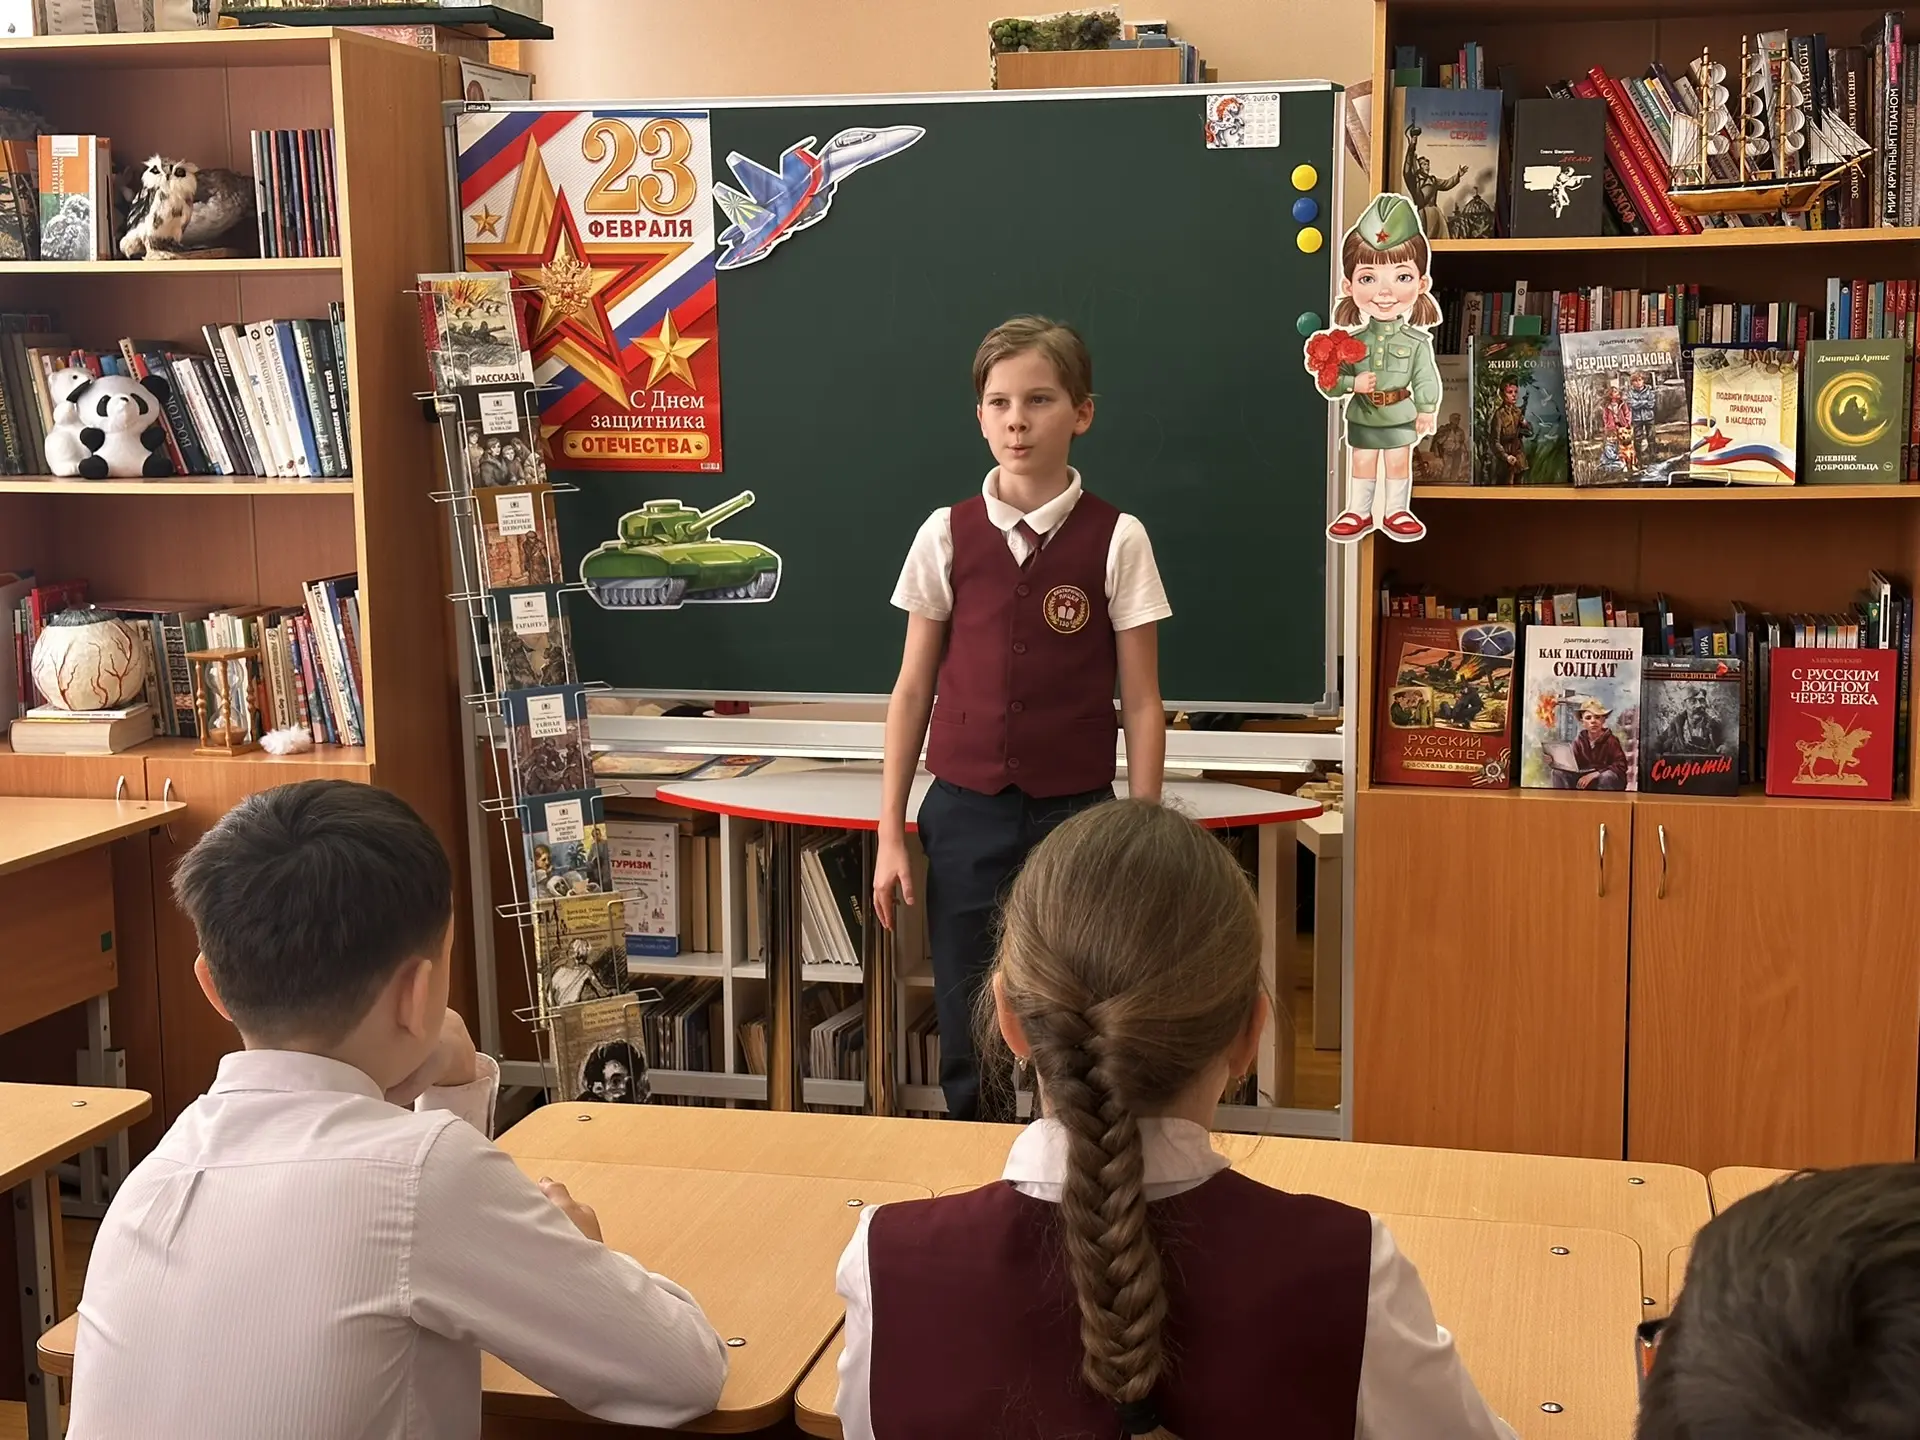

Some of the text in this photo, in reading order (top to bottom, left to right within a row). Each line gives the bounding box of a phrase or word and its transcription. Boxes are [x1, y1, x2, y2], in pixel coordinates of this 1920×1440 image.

[1847, 71, 1856, 111] ДИСНЕЯ
[1613, 104, 1635, 136] ИСТОРИИ
[1889, 88, 1898, 135] ПЛАНОМ
[1630, 136, 1648, 160] АТЛАС
[582, 118, 697, 216] 23
[1887, 138, 1897, 188] КРУПНЫМ
[1903, 107, 1915, 226] СОВРЕМЕННАЯ ЭНЦИКЛОПЕДИЯ
[1887, 191, 1895, 212] МИР
[588, 220, 692, 238] ФЕВРАЛЯ
[1488, 360, 1522, 369] ЖИВИ,
[1575, 355, 1618, 370] СЕРДЦЕ
[1620, 352, 1672, 368] ДРАКОНА
[1818, 354, 1890, 363] Дмитрий Артис
[630, 390, 705, 412] С Днем
[591, 413, 705, 429] защитника
[1731, 416, 1766, 426] НАСЛЕДСТВО
[0, 414, 14, 457] БОЛЬШАЯ
[581, 432, 692, 454] ОТЕЧЕСТВА
[1815, 455, 1857, 464] ДНЕВНИК
[1815, 463, 1879, 471] ДОБРОВОЛЬЦА
[1539, 648, 1633, 660] КАК НАСТОЯЩИЙ
[1553, 662, 1618, 679] СОЛДАТ
[1792, 668, 1879, 681] С РУССКИМ
[1801, 680, 1869, 693] ВОИНОМ
[1790, 692, 1879, 705] ЧЕРЕЗ ВЕКА
[1408, 734, 1481, 748] РУССКИЙ
[1403, 746, 1487, 760] ХАРАКТЕР
[1651, 756, 1732, 786] Солдаты
[611, 860, 651, 869] ТУРИЗМ
